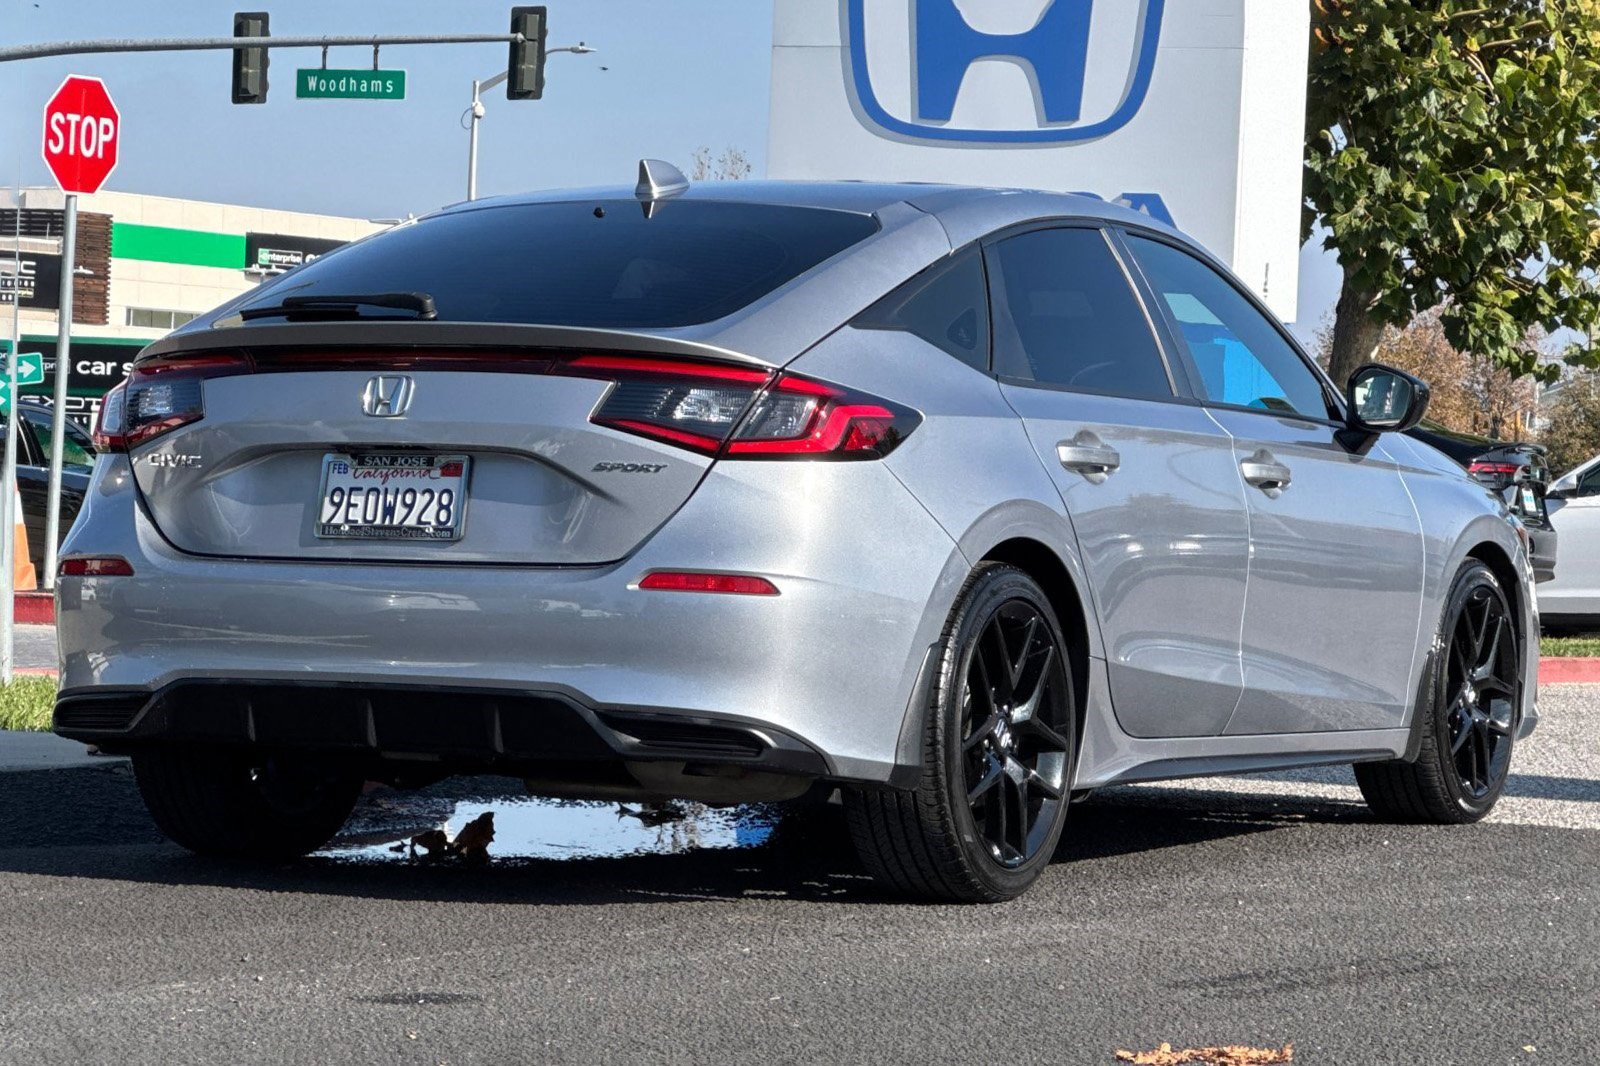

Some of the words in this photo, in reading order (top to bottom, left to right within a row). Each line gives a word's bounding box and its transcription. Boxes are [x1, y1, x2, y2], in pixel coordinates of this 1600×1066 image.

[307, 75, 394, 94] Woodhams
[48, 111, 115, 160] STOP
[76, 360, 117, 376] car
[147, 453, 202, 467] CIVIC
[363, 456, 392, 466] SAN
[394, 456, 428, 467] JOSE
[331, 463, 349, 475] FEB
[591, 462, 668, 474] SPORT
[352, 467, 440, 485] California
